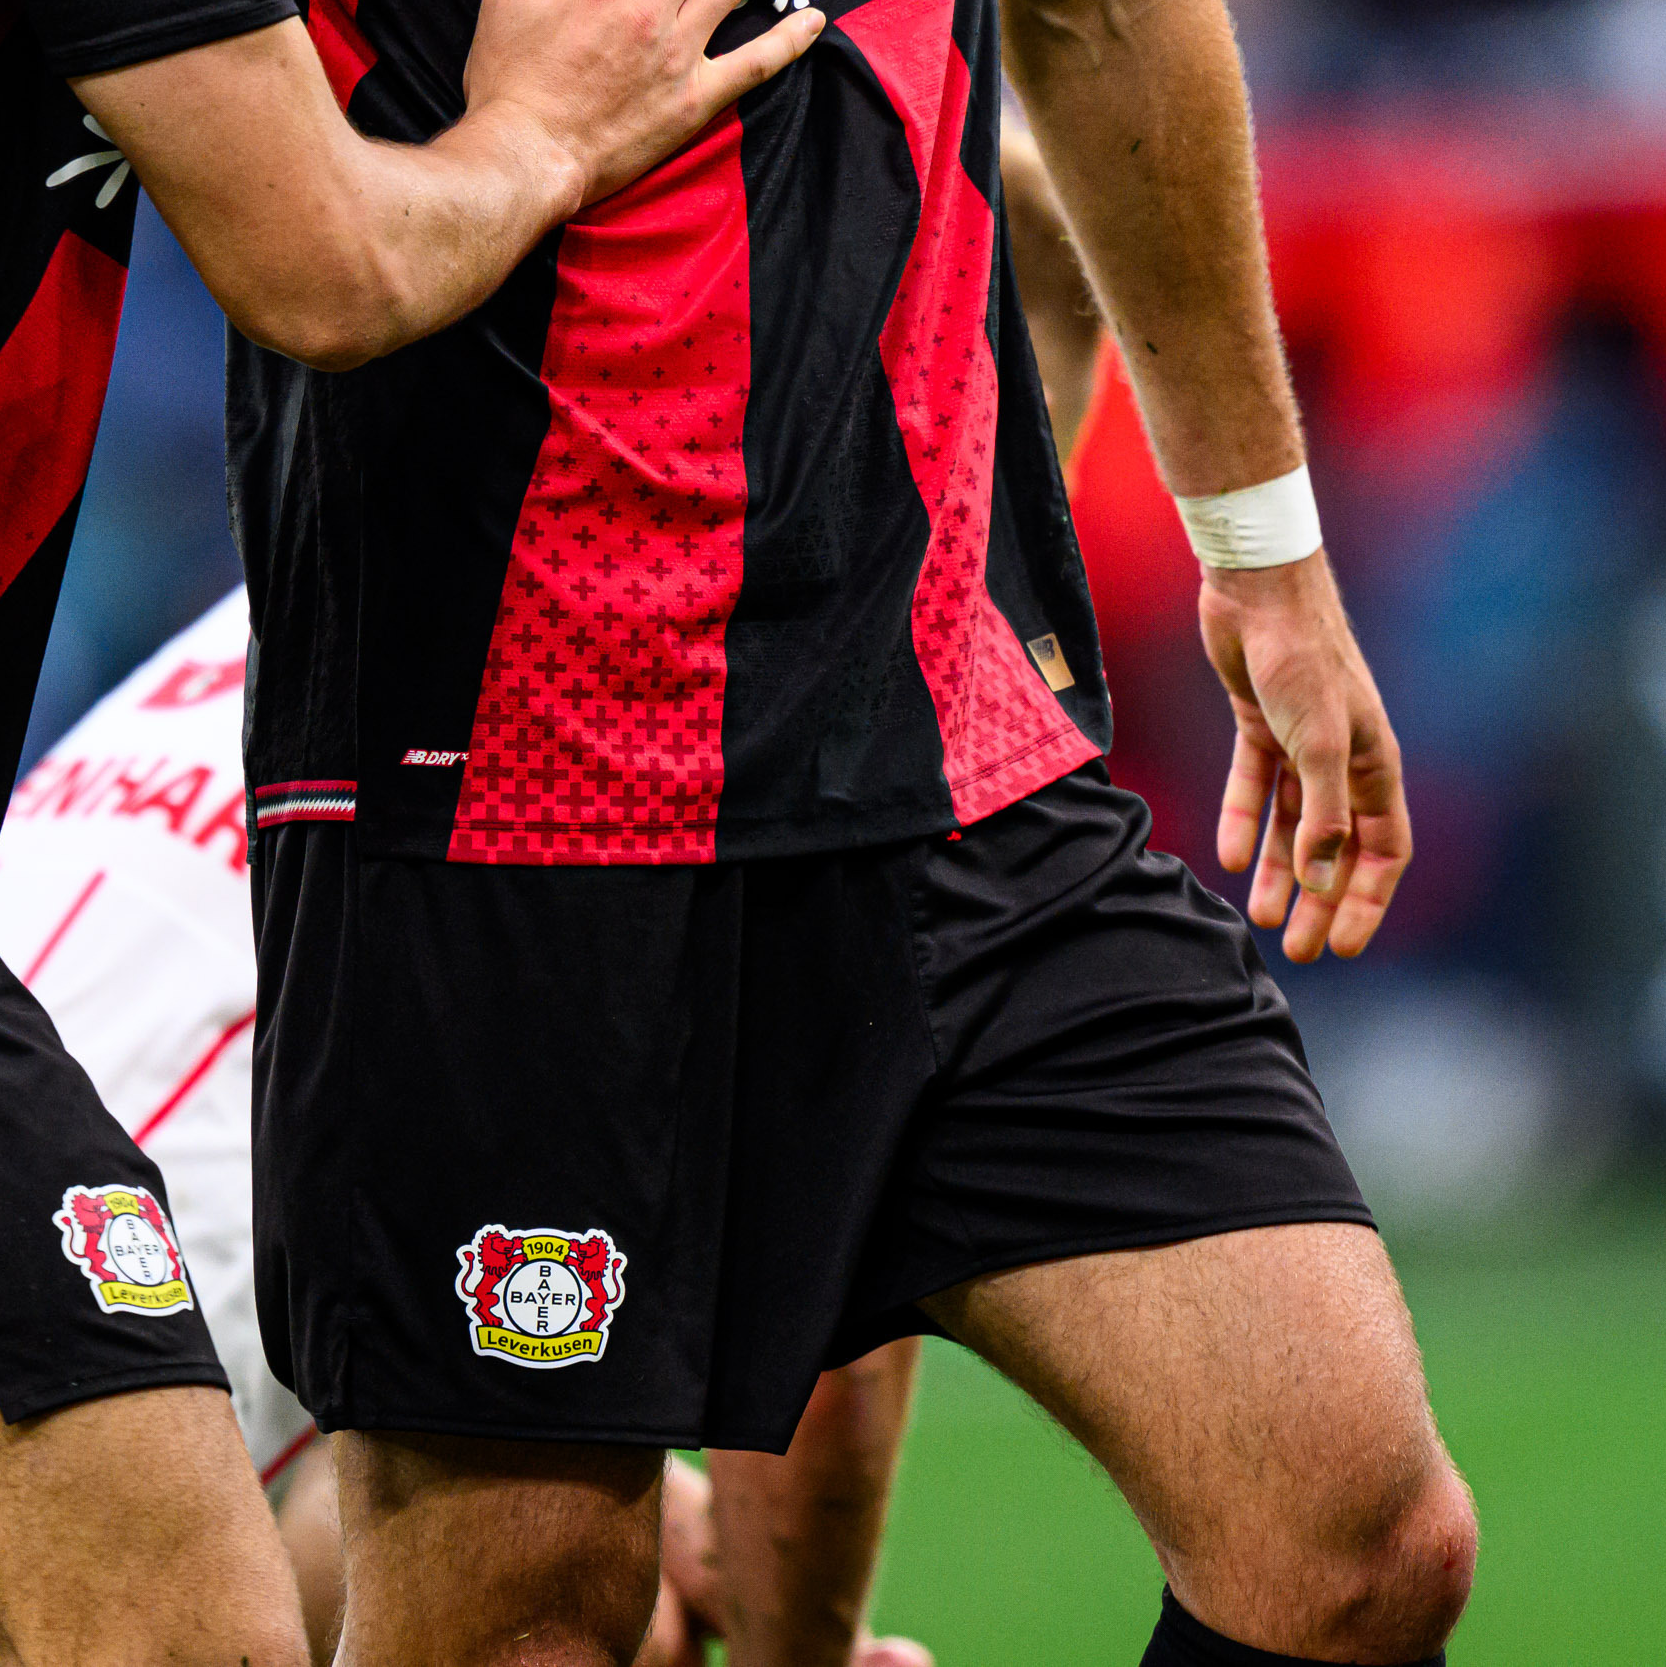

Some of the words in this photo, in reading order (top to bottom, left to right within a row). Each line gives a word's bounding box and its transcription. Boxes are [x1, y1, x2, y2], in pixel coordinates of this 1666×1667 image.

[527, 1241, 564, 1256] 1904
[108, 1286, 183, 1304] Leverkusen
[510, 1291, 576, 1306] BAYER
[536, 1265, 551, 1333] BAYER
[487, 1330, 593, 1357] Leverkusen
